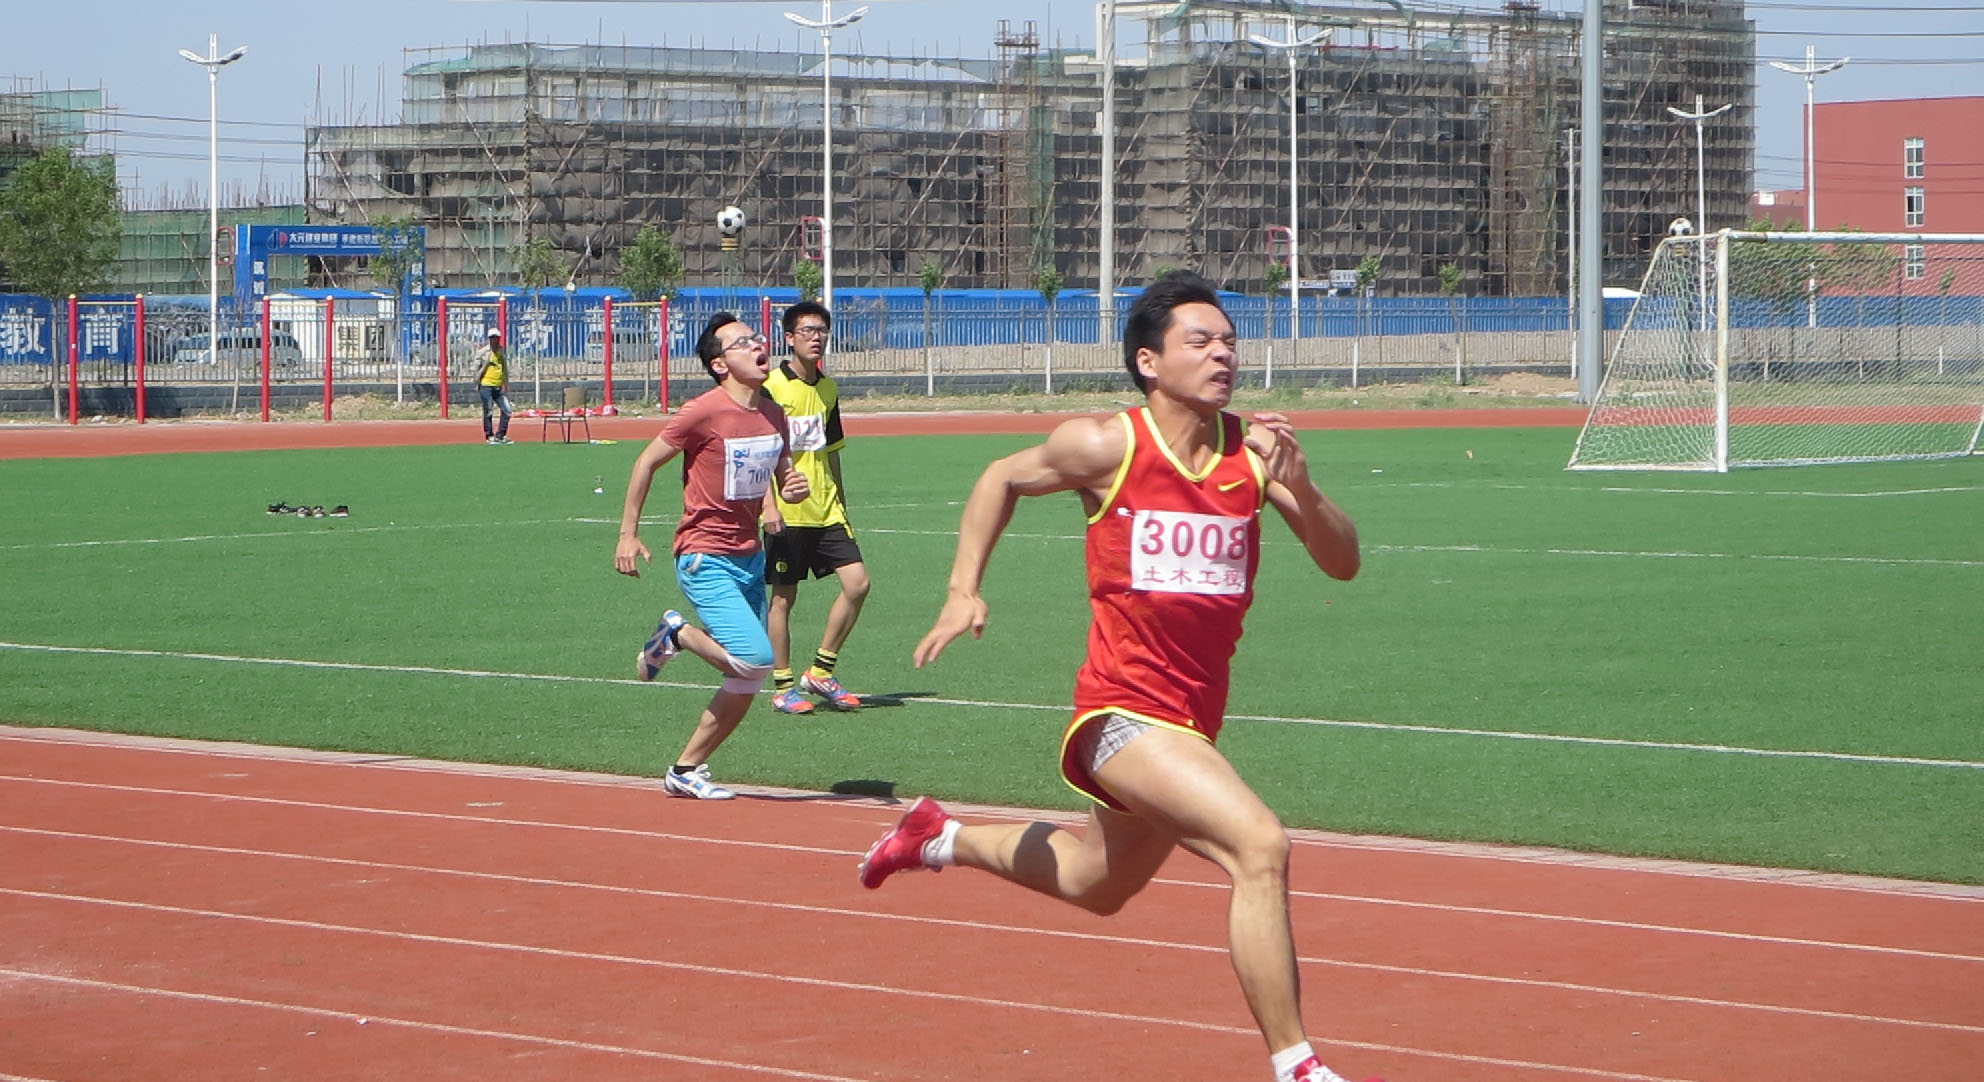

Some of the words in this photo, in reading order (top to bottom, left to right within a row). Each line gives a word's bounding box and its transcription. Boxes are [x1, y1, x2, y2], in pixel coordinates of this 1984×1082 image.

[1140, 518, 1246, 560] 3008
[1142, 565, 1245, 591] 土木工程
